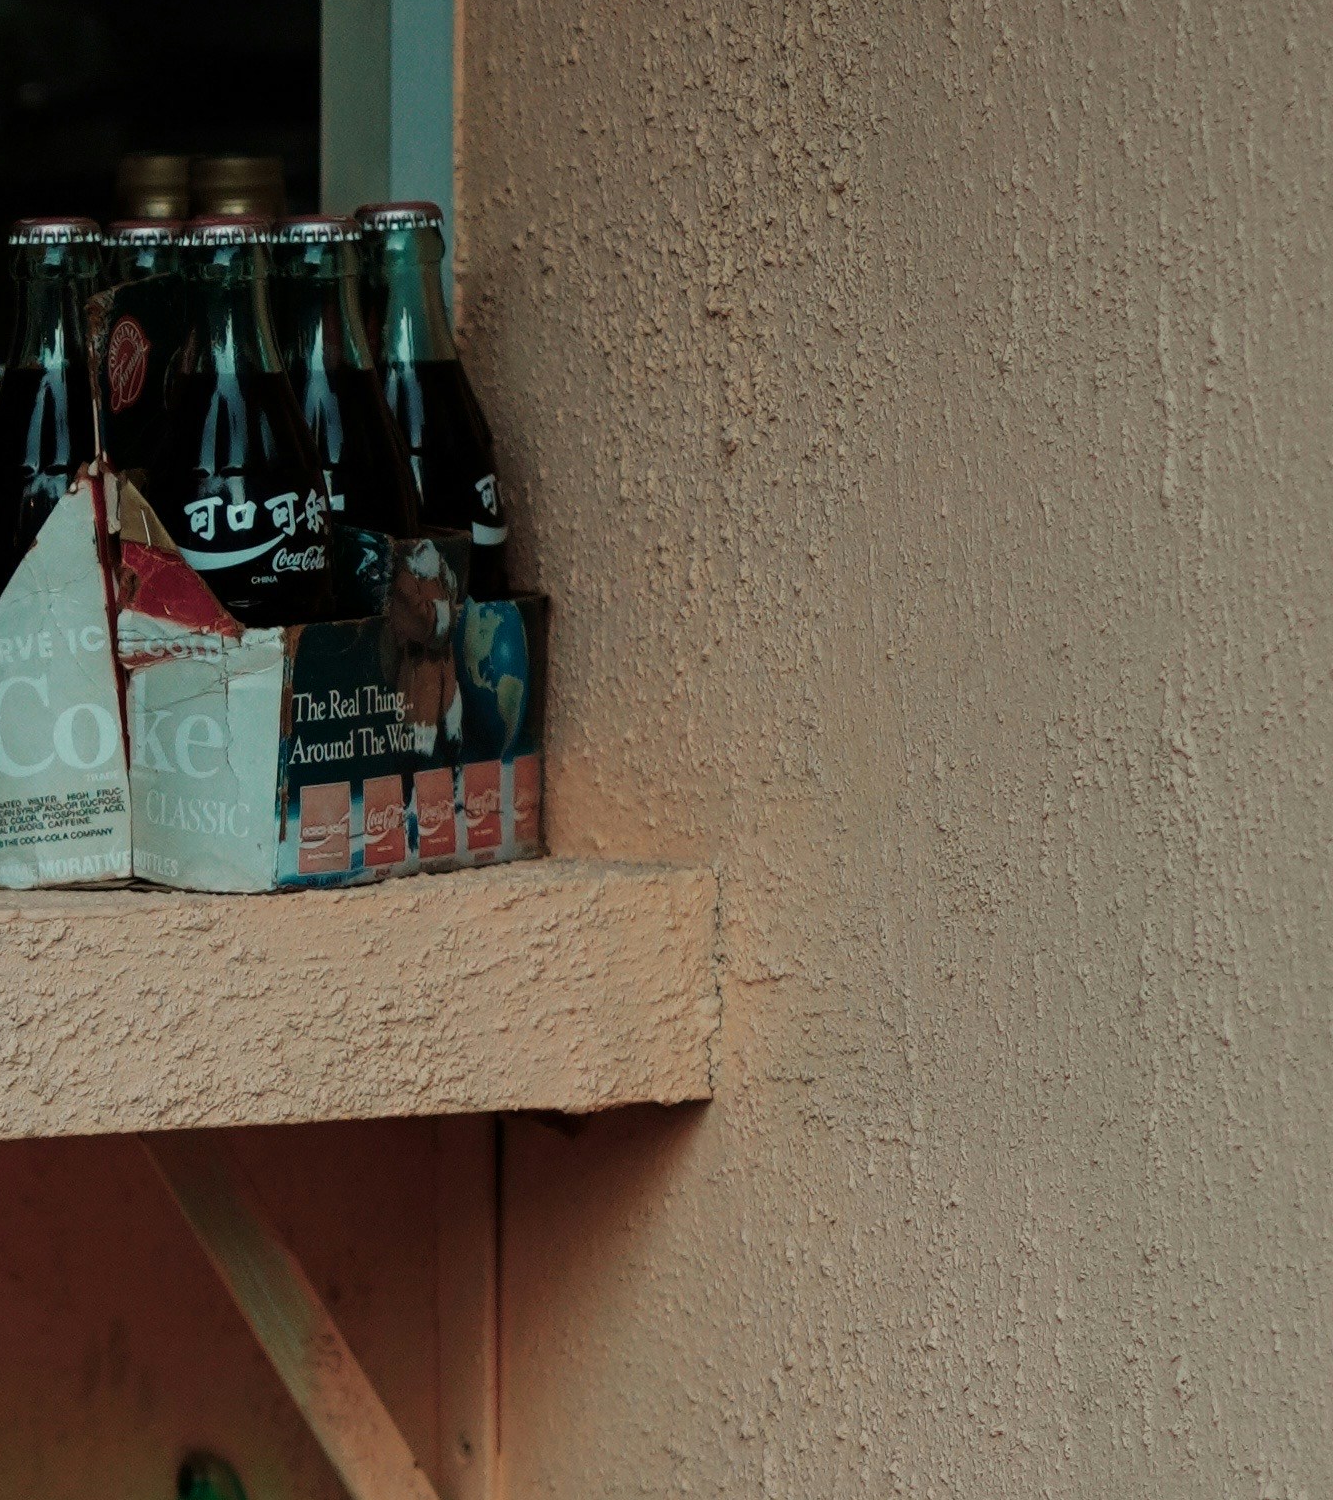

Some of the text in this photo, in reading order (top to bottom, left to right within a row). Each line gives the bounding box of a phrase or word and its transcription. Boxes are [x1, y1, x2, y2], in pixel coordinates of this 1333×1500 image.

[183, 488, 327, 541] 可口可乐
[250, 575, 278, 585] CHINA
[292, 693, 326, 724] The
[329, 688, 361, 719] Real
[288, 728, 355, 766] Around
[357, 726, 386, 756] The
[145, 788, 251, 838] CLASSIC
[70, 827, 115, 840] COMPANY
